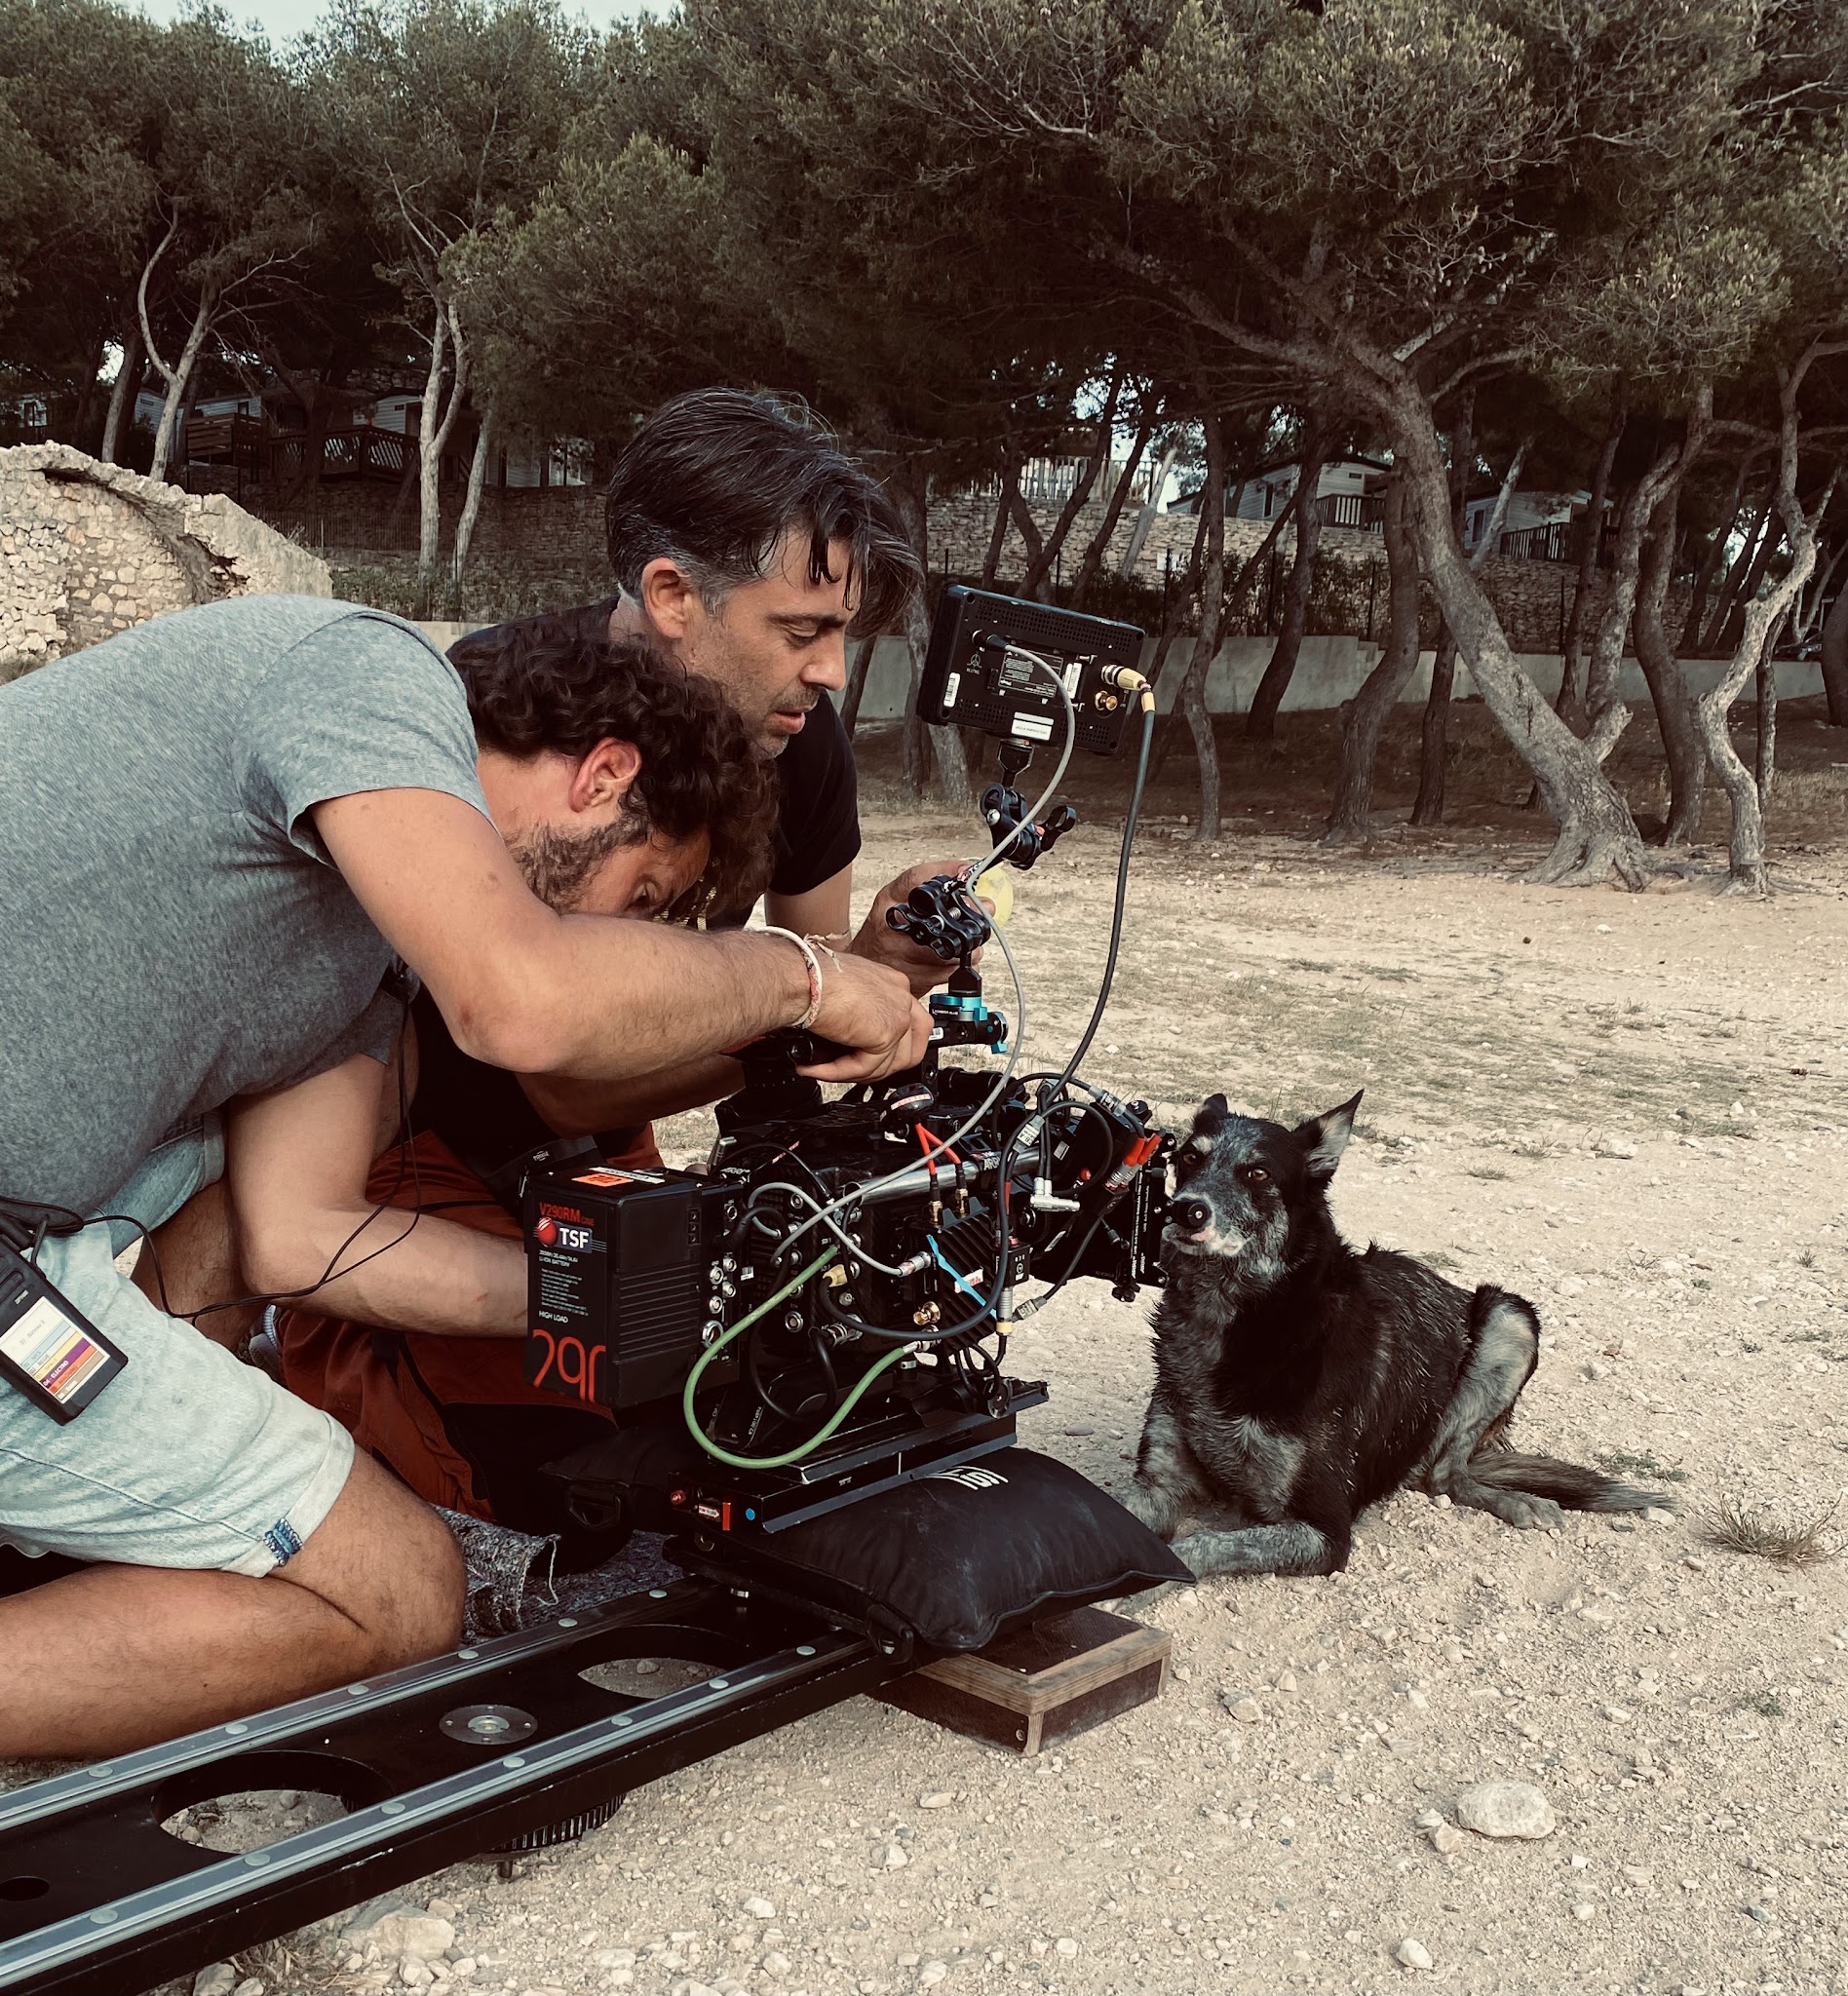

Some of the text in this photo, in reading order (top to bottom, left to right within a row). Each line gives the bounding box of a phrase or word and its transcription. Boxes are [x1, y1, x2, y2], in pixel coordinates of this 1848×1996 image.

[539, 1202, 581, 1223] V290RM
[559, 1227, 590, 1248] TSF
[538, 1310, 569, 1324] HIGH LOAD
[50, 1360, 69, 1379] ELECTRO
